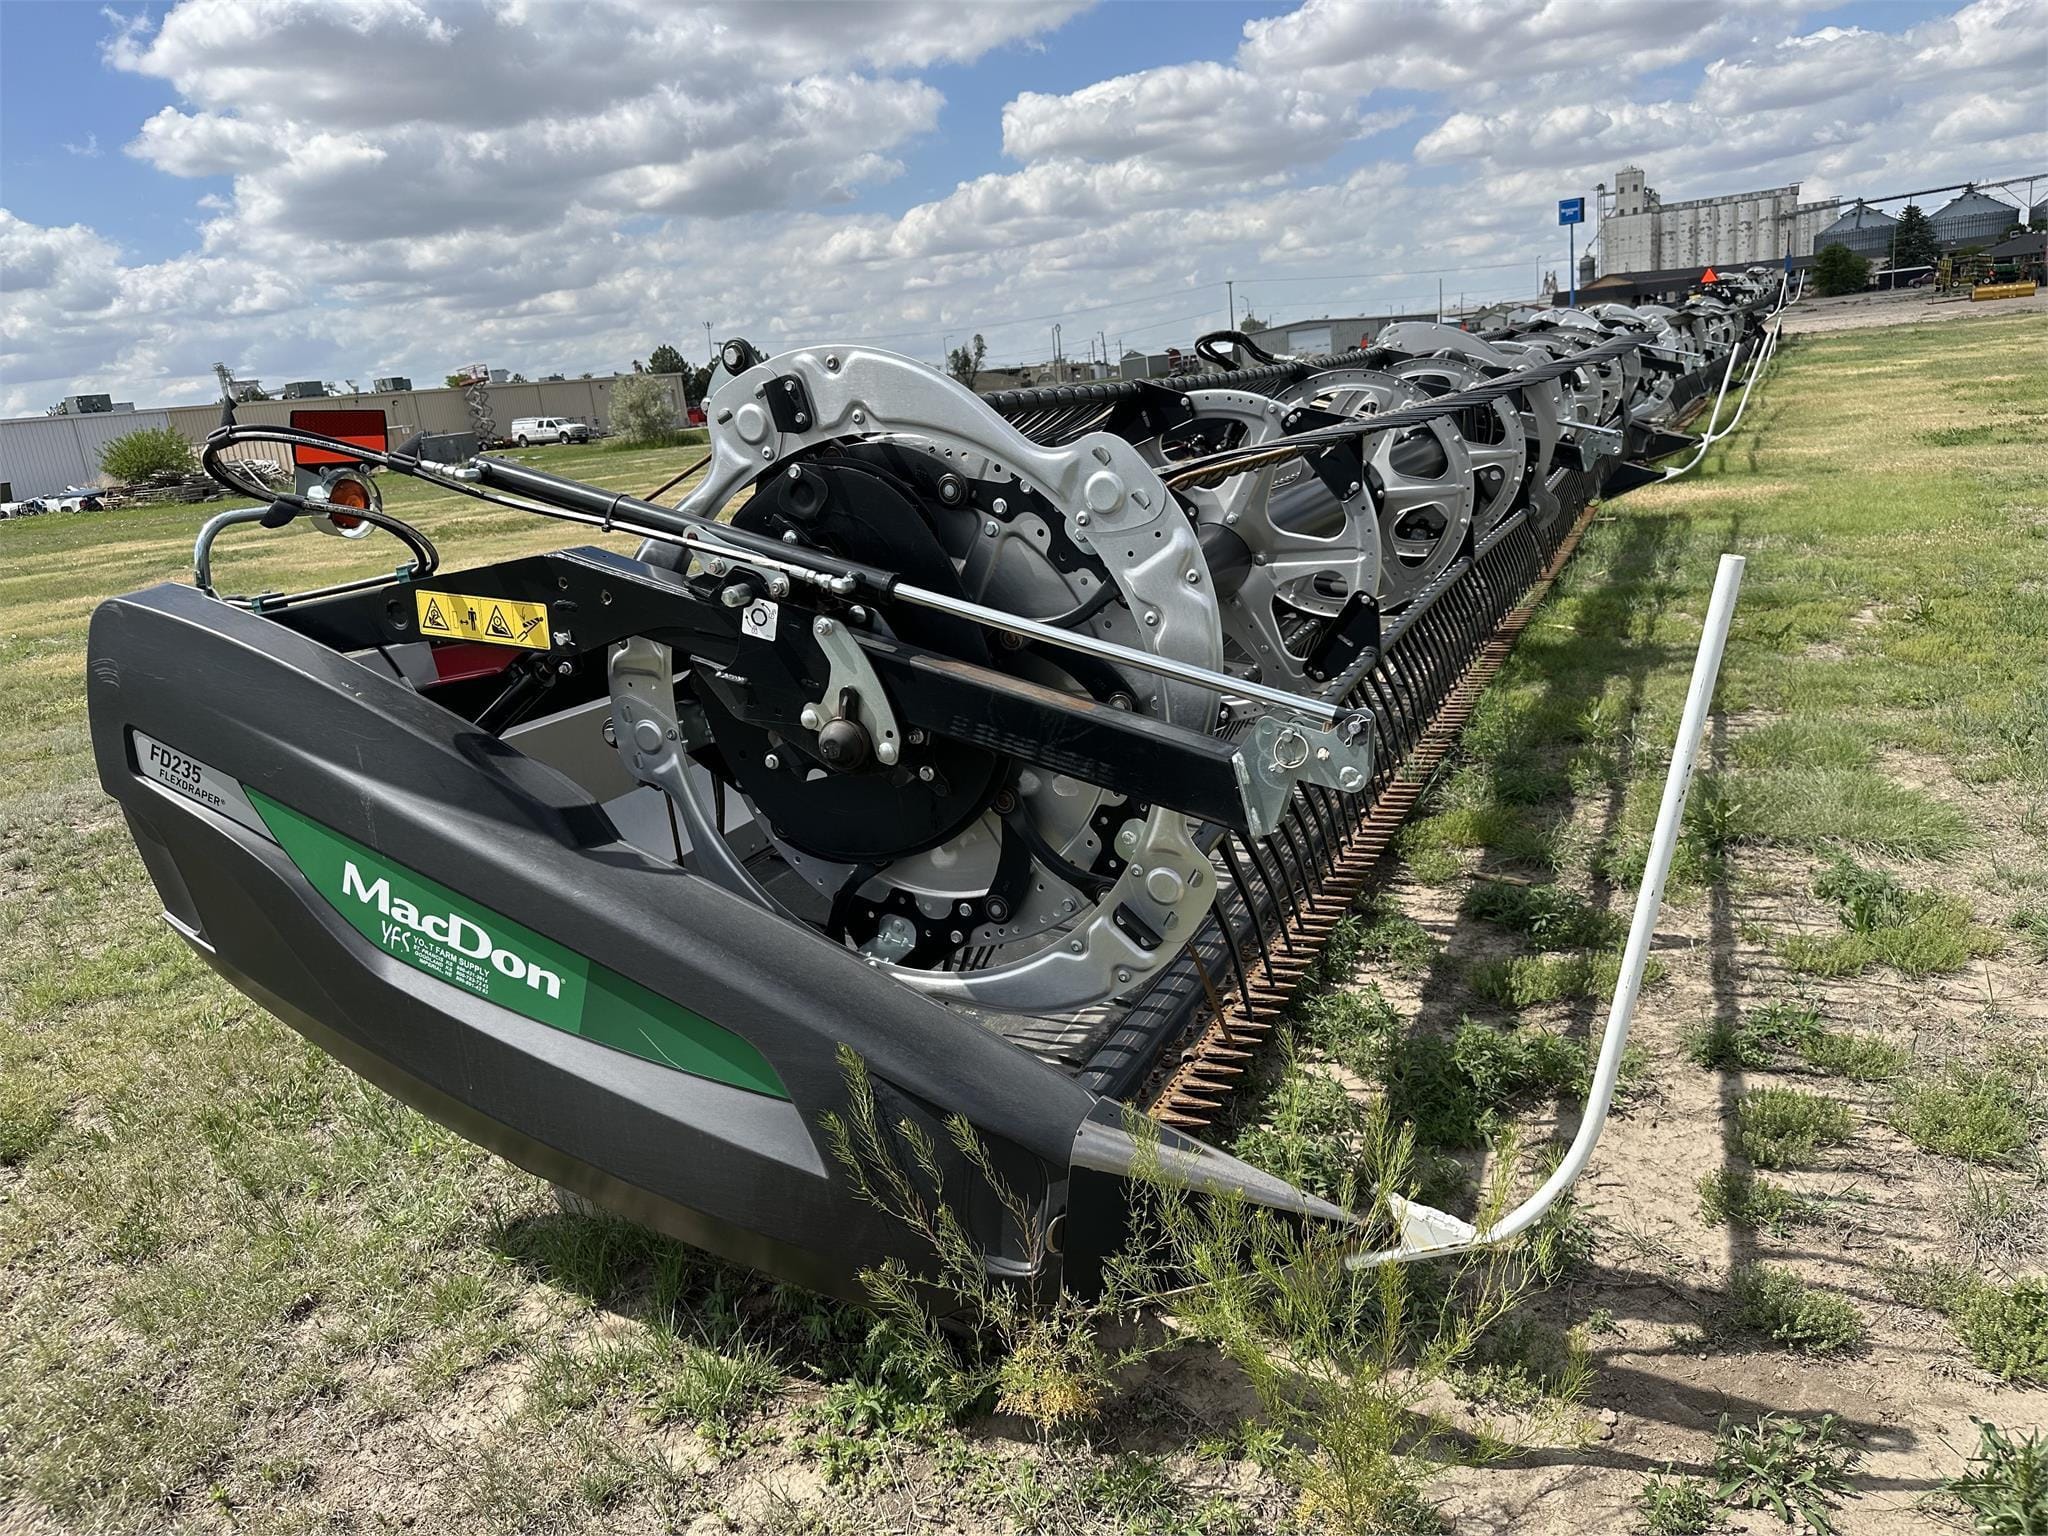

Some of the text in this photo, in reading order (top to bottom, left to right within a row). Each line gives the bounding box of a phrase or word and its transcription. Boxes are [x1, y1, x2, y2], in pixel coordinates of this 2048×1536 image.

[150, 743, 202, 784] FD235
[413, 935, 490, 978] YOT FARM SUPPLY
[414, 950, 444, 968] GOODLAND
